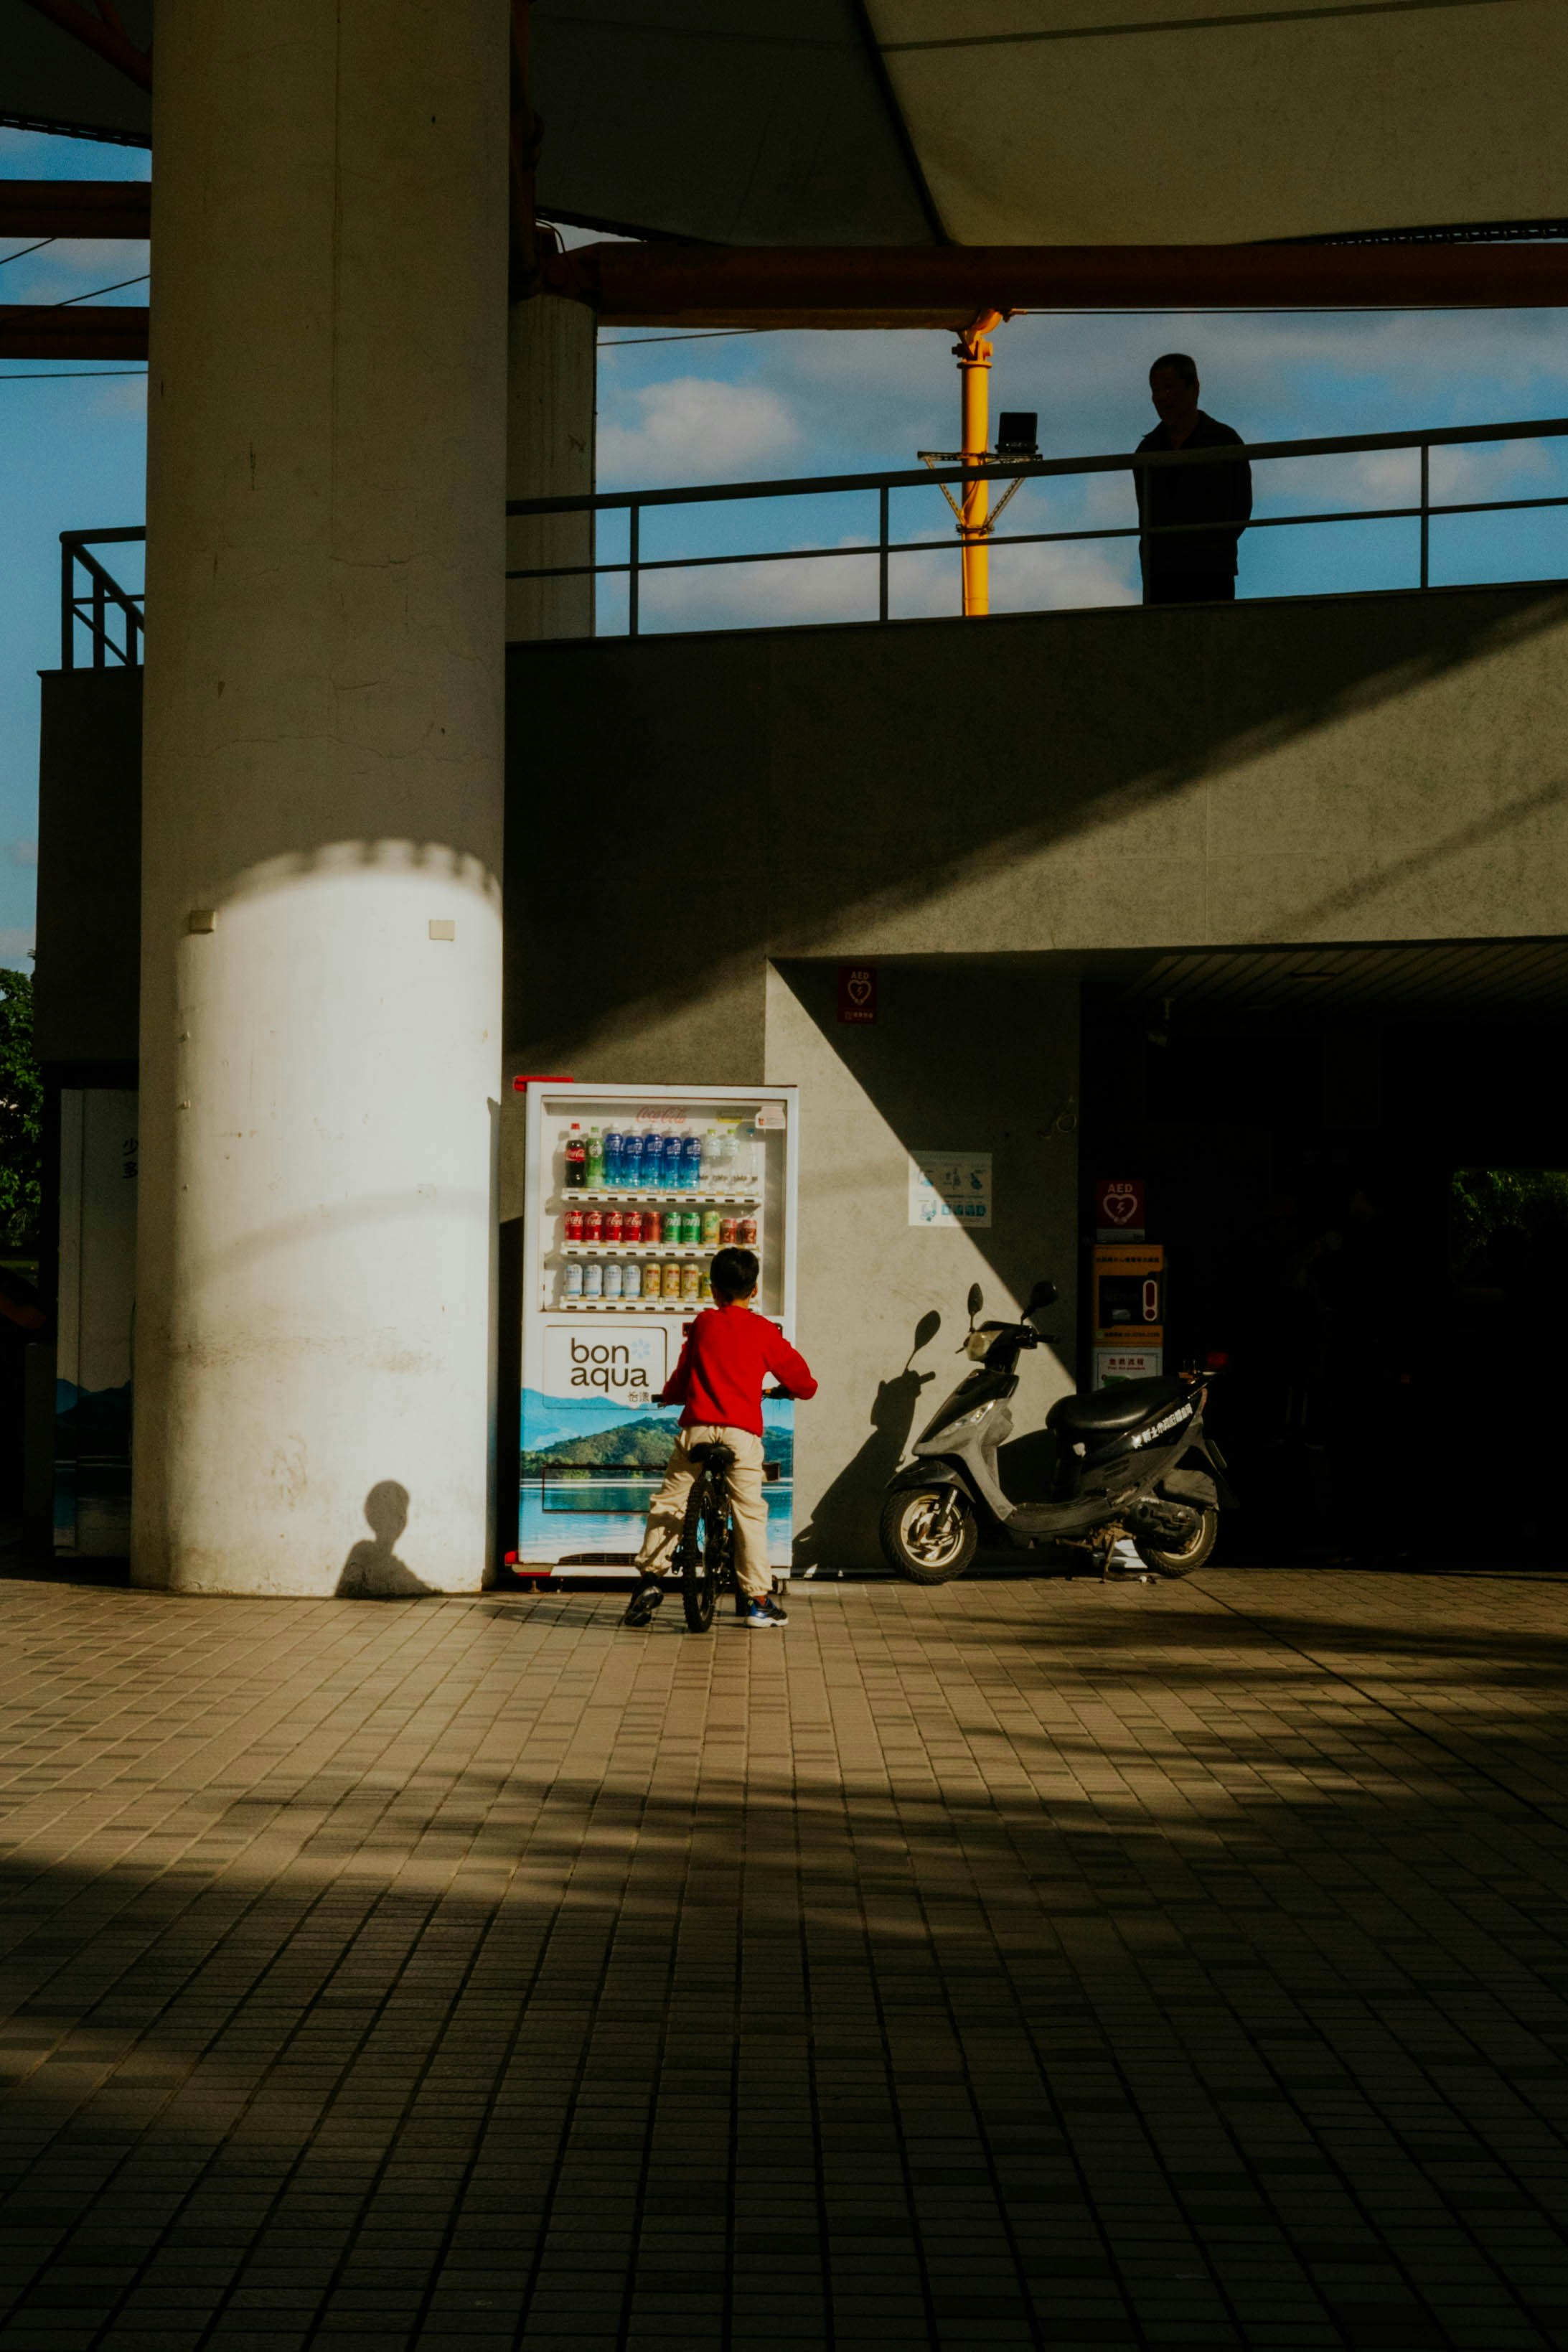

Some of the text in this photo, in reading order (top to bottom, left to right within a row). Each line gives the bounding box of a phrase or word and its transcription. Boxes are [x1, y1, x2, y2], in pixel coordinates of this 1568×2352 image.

[850, 970, 870, 980] AED
[1107, 1183, 1134, 1193] AED
[571, 1337, 629, 1364] bon
[571, 1367, 649, 1393] aqua
